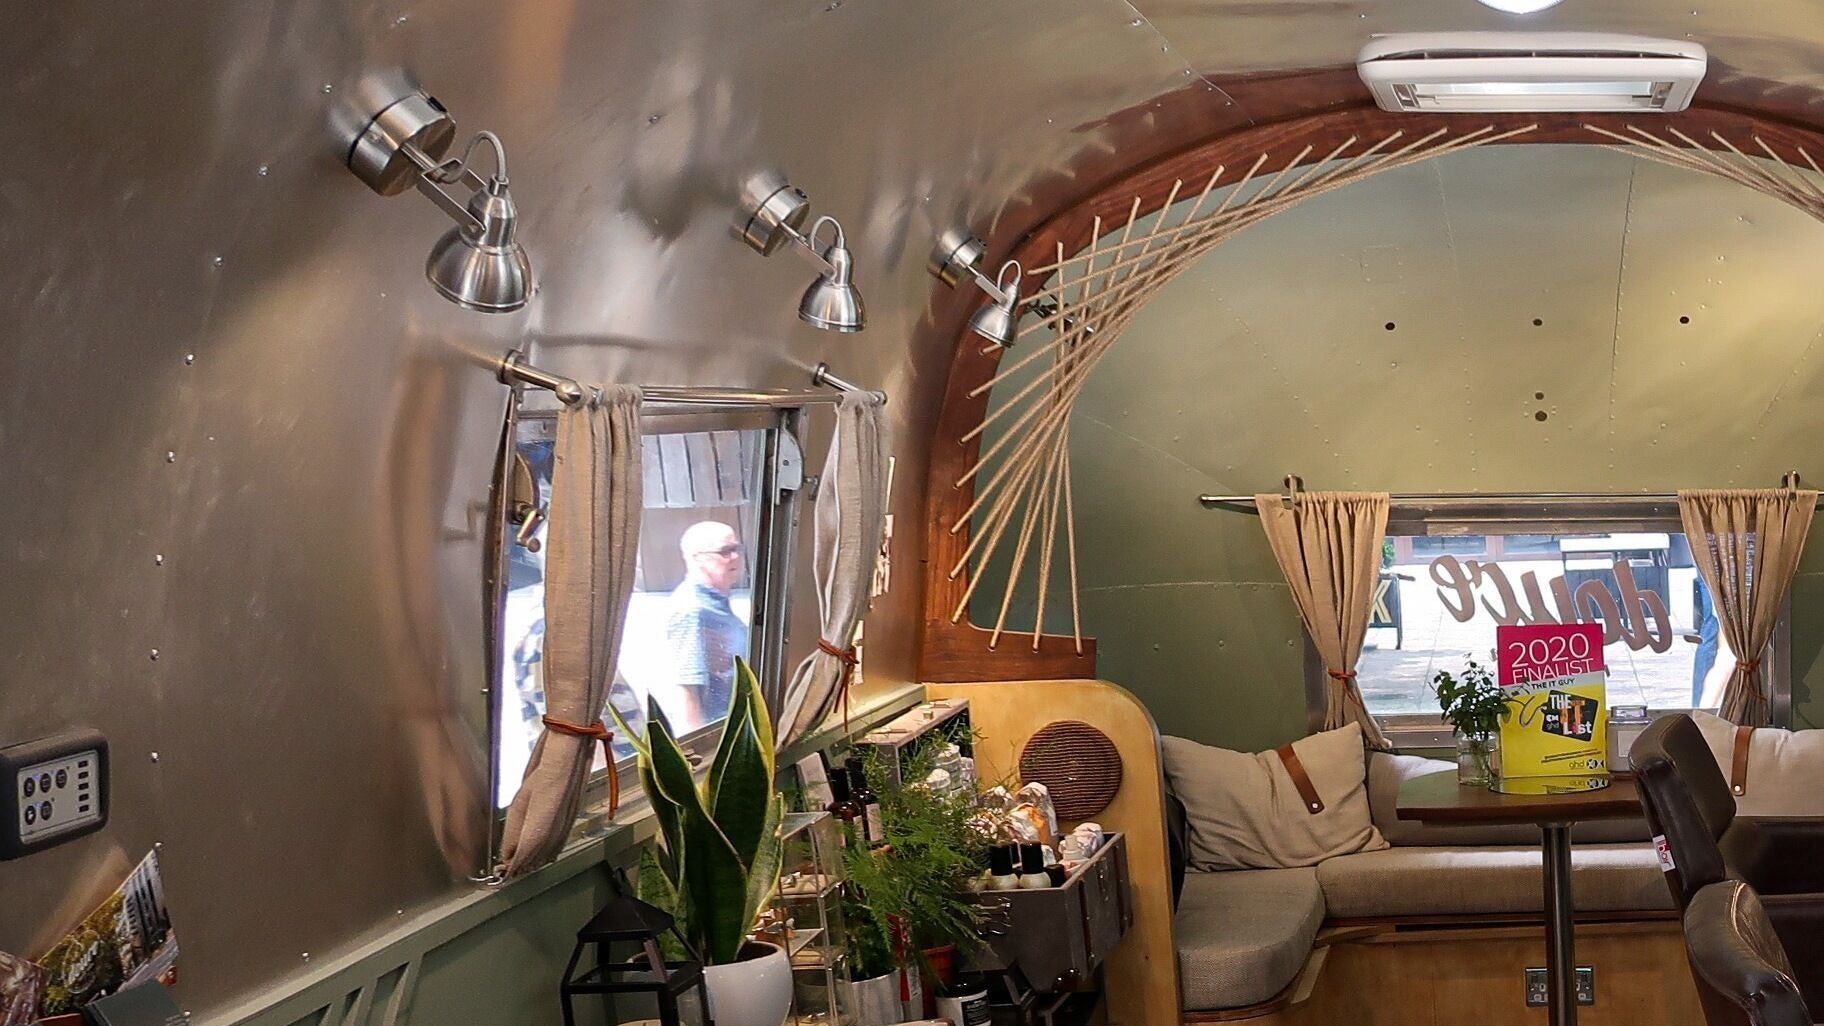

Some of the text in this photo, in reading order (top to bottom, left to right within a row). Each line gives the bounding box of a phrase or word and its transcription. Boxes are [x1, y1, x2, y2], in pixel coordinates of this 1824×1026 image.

[1508, 633, 1590, 668] 2020
[1512, 658, 1594, 685] FINALIST
[1531, 678, 1576, 691] THE IT GUY
[1550, 694, 1572, 709] THE
